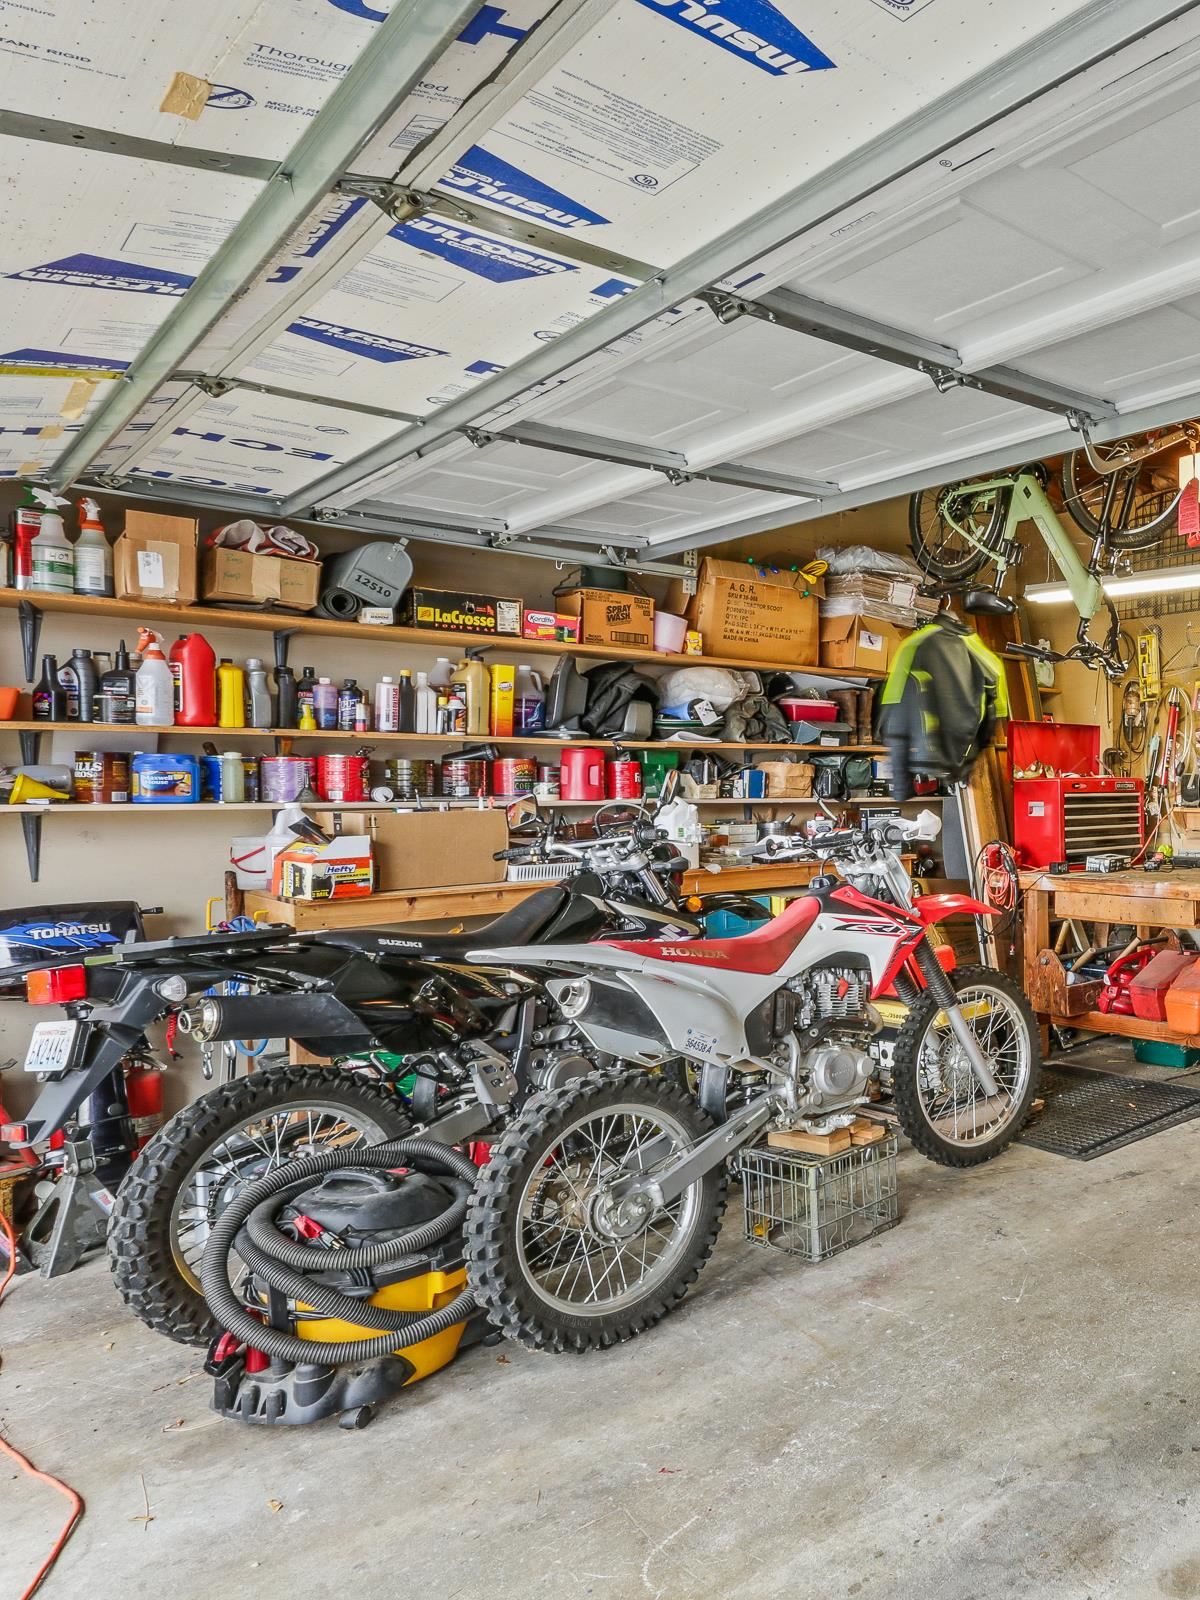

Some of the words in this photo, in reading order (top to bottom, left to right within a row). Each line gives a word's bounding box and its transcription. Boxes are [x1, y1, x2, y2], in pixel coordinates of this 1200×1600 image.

[606, 604, 632, 615] SPRAY
[435, 608, 496, 628] LaCrosse
[606, 613, 632, 622] WASH
[326, 864, 355, 874] Hefty
[31, 922, 112, 941] TOHATSU
[377, 937, 423, 949] SUZUKI
[660, 945, 729, 961] HONDA
